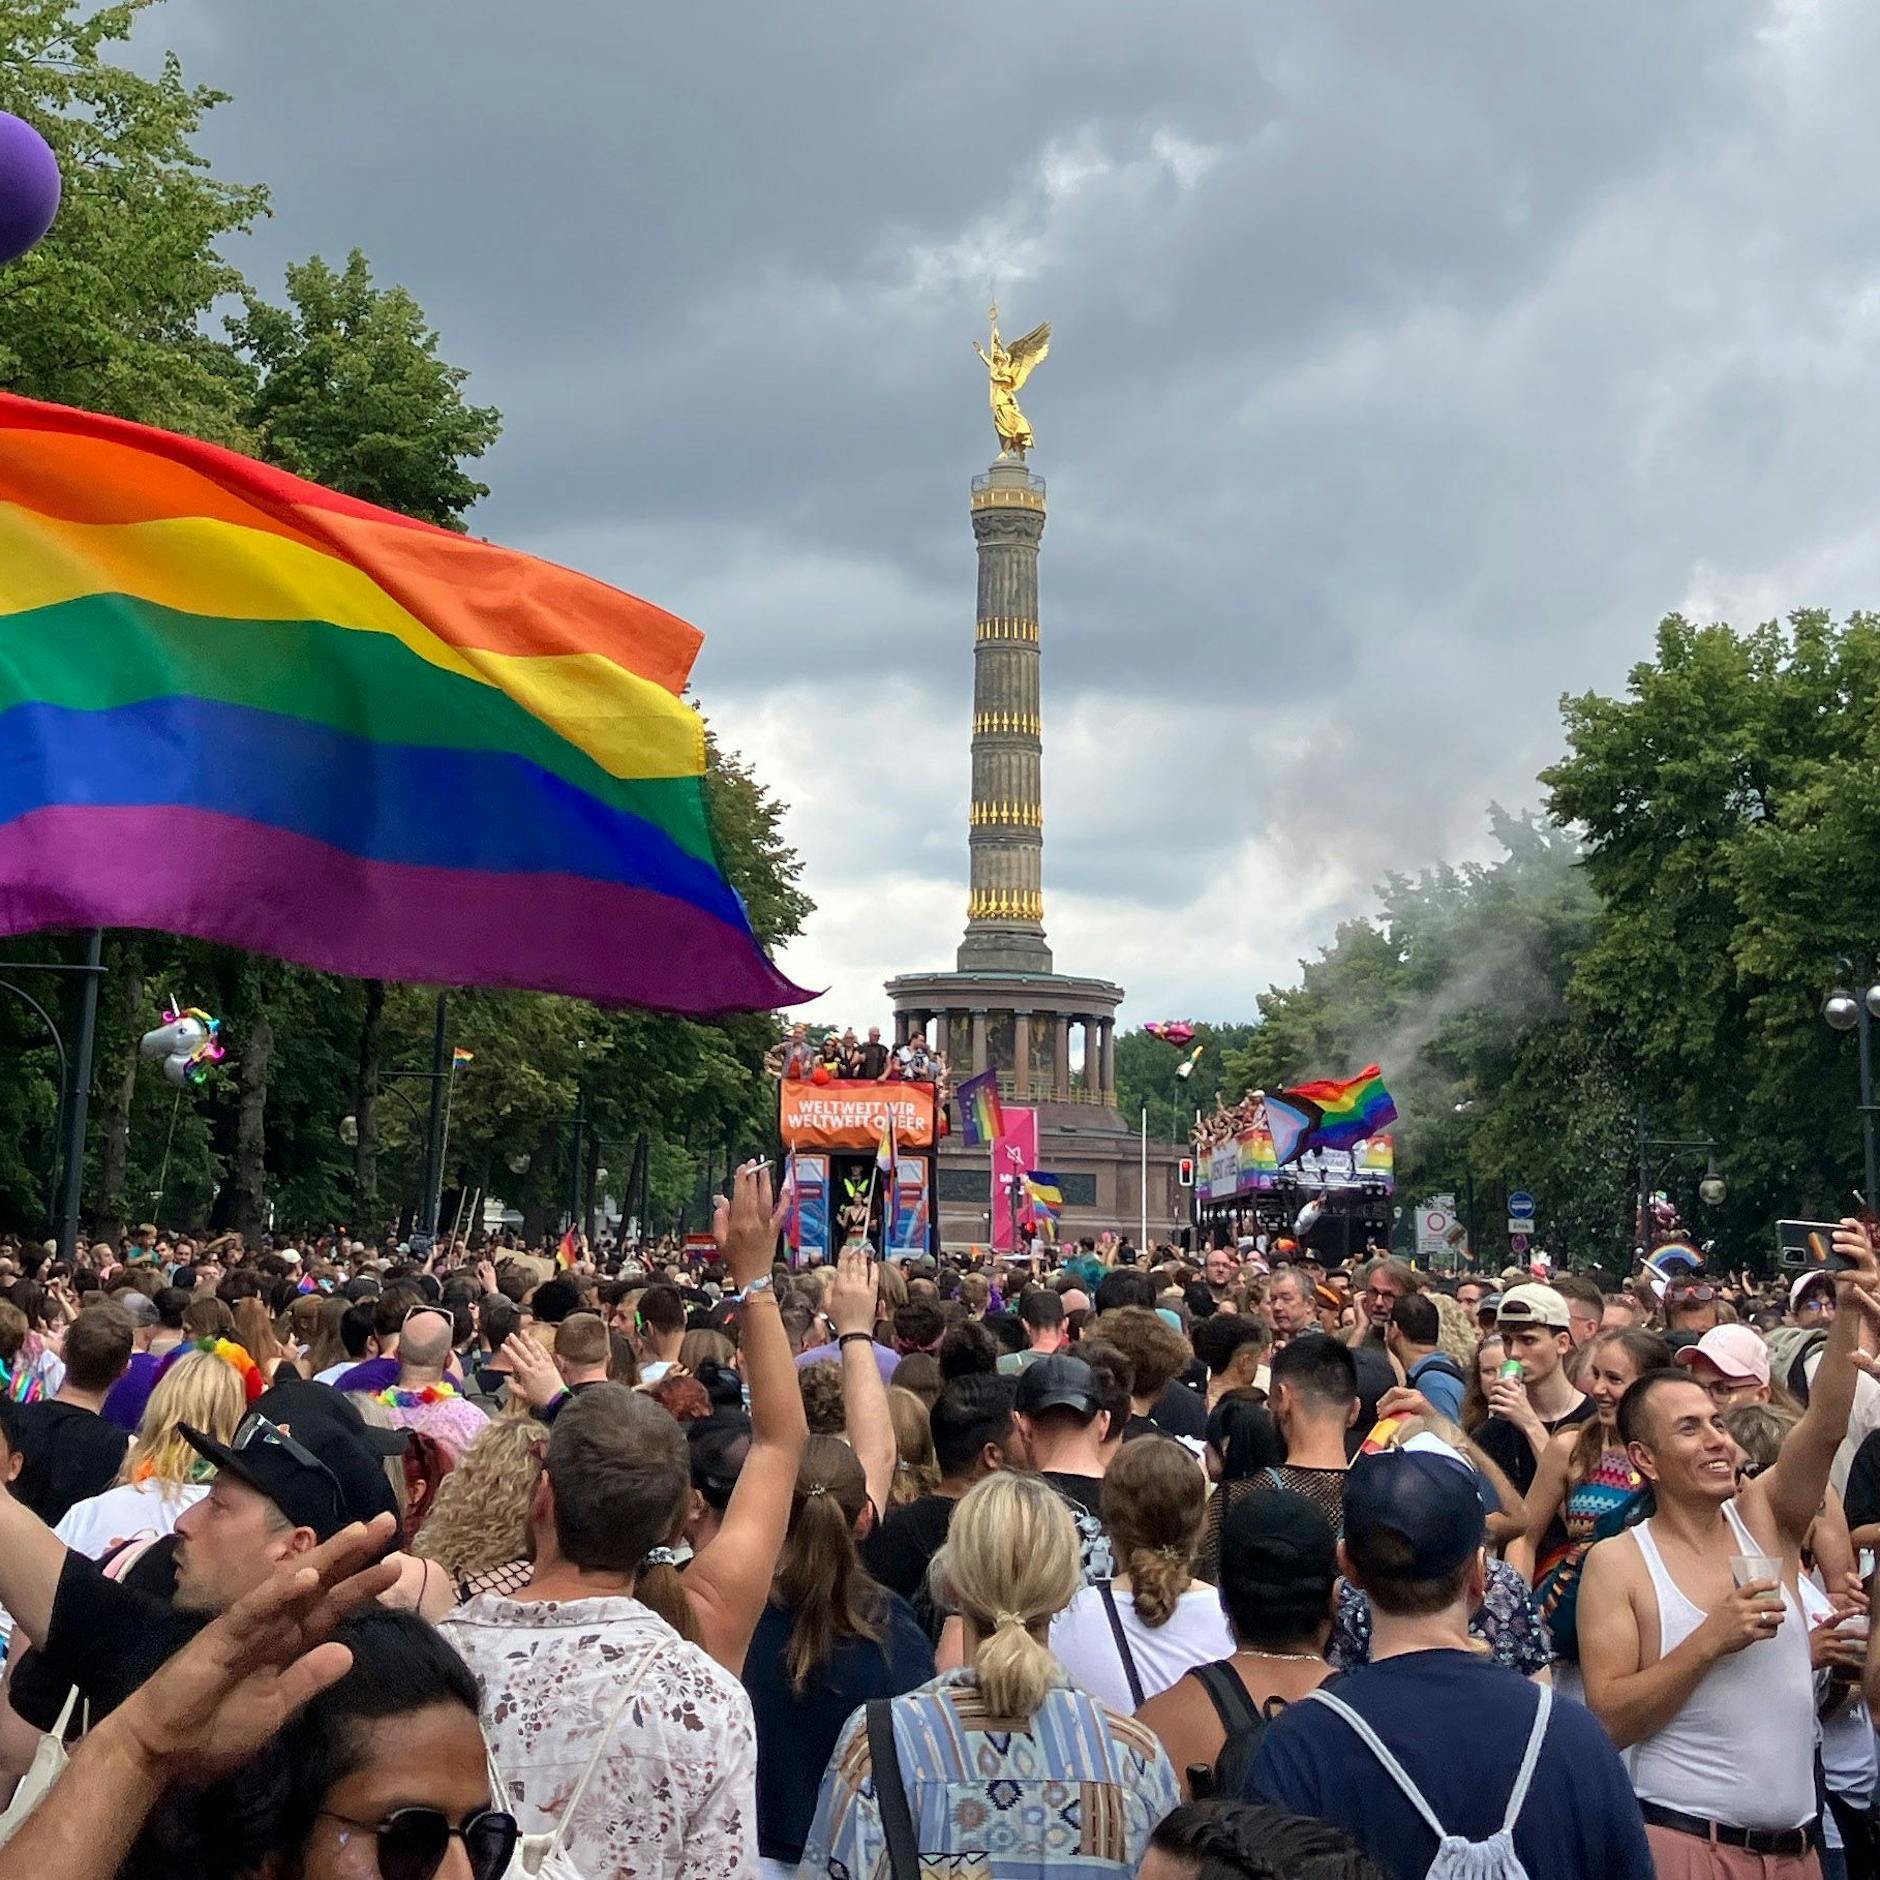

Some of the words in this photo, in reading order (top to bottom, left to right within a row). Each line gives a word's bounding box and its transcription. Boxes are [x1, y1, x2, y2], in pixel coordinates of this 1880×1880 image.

[798, 1100, 881, 1114] WELTWEIT
[884, 1101, 915, 1115] WIR
[787, 1114, 870, 1128] WELTWEIT
[873, 1115, 926, 1130] QEER
